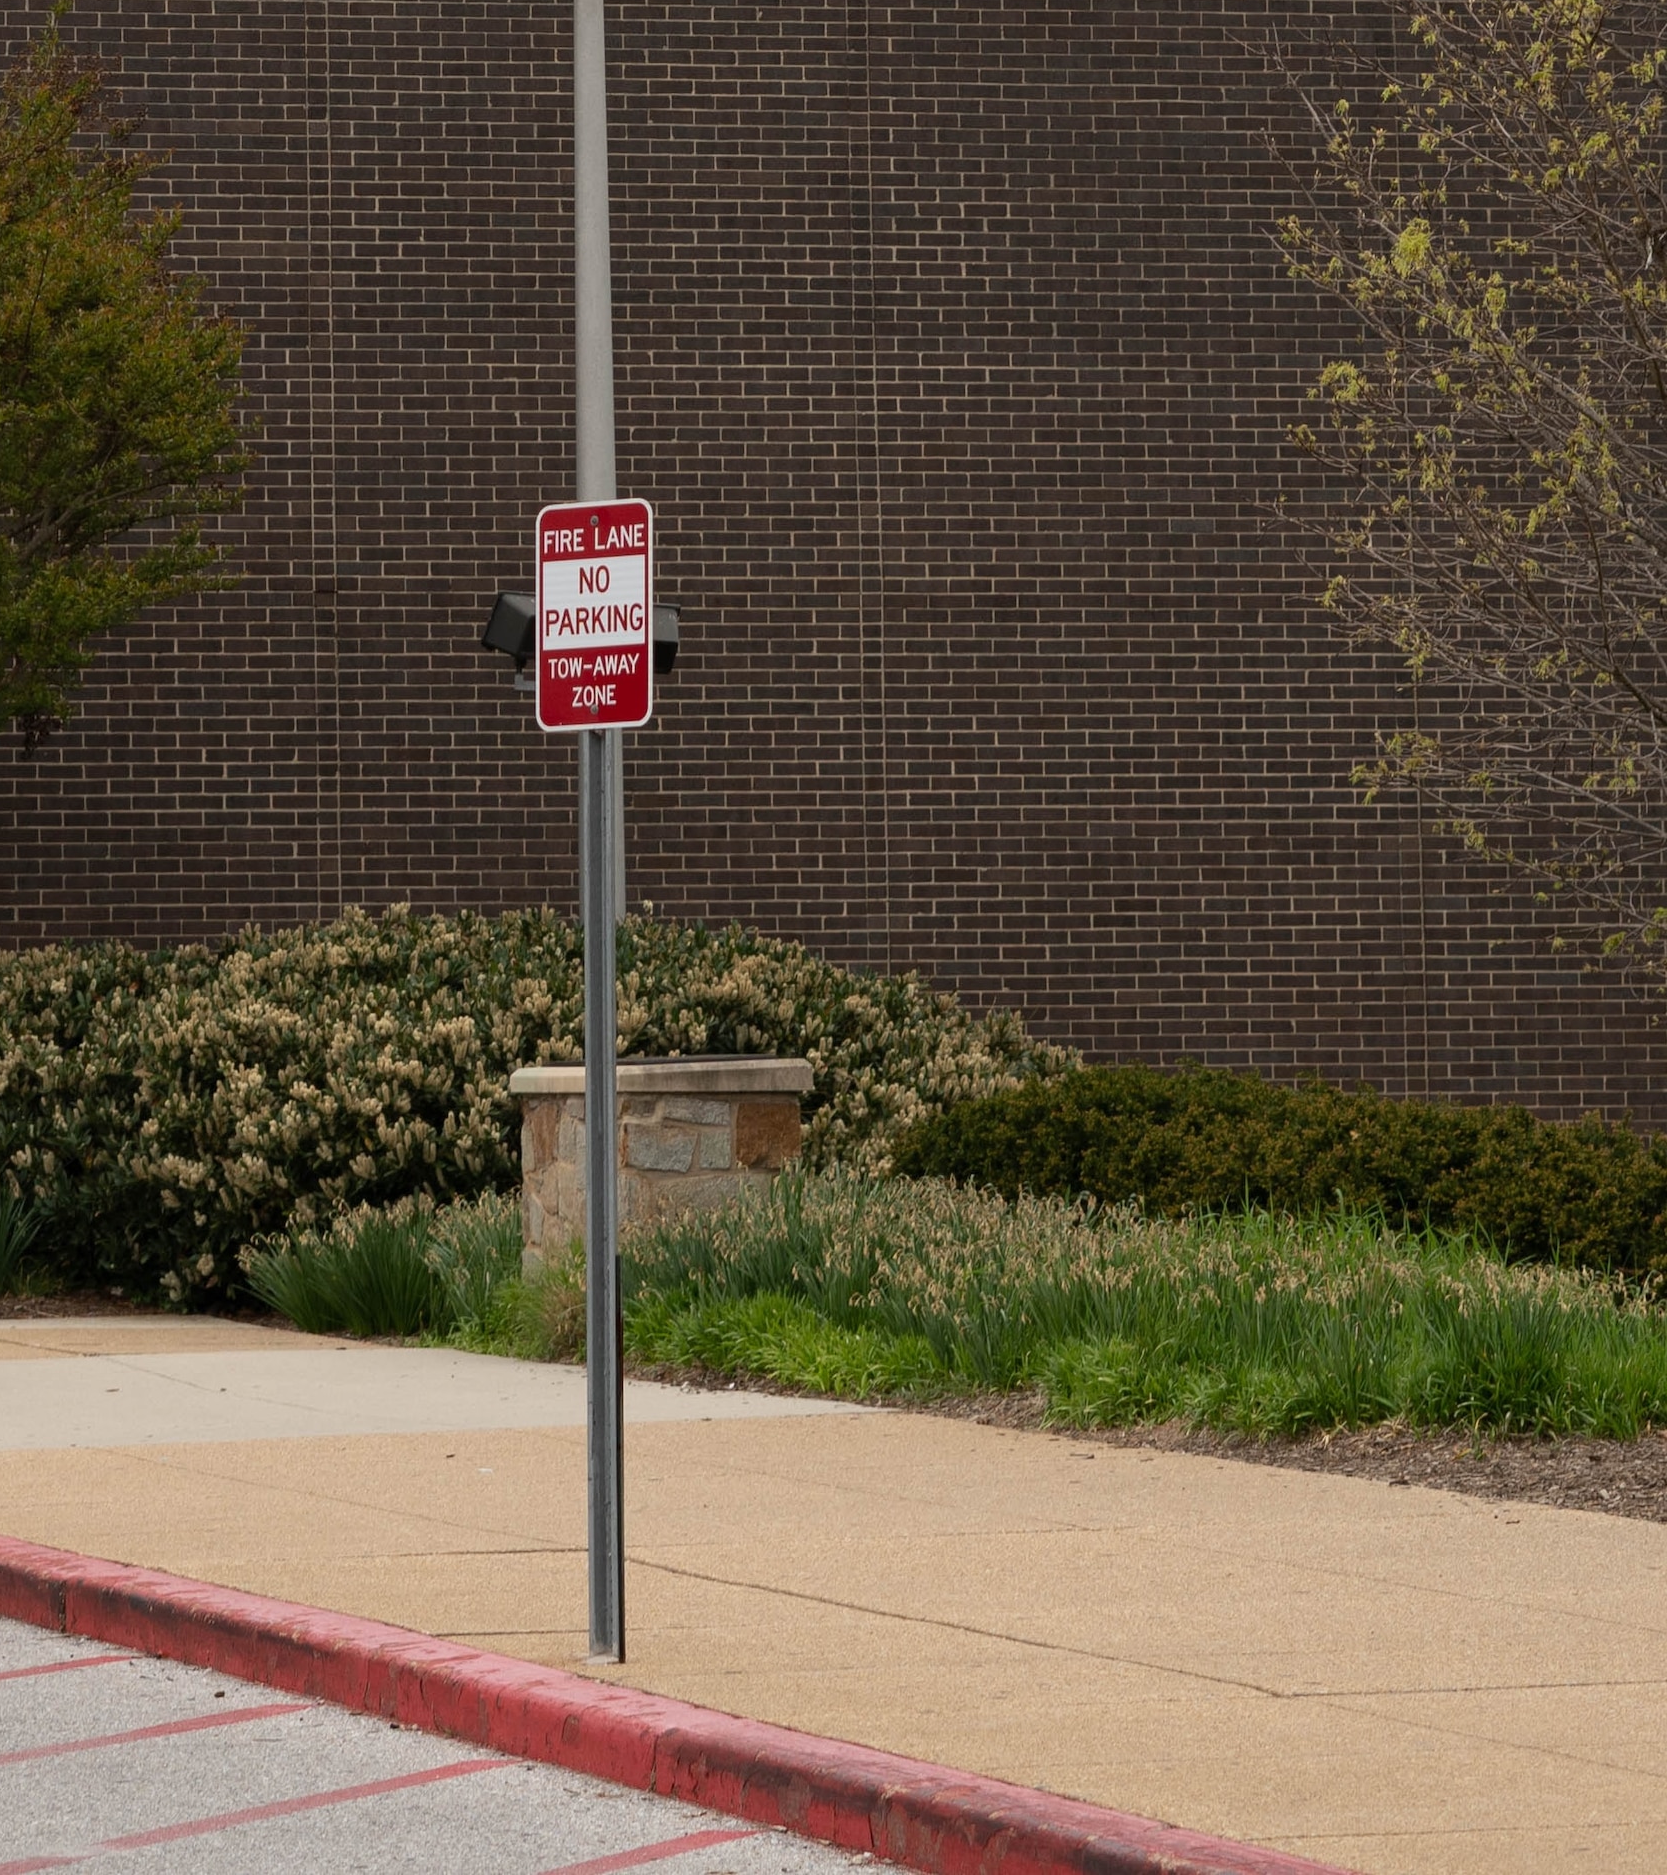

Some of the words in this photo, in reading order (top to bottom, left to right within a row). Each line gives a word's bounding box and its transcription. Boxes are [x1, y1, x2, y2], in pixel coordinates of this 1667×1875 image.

[543, 528, 585, 554] FIRE
[594, 523, 645, 550] LANE
[579, 565, 610, 594] NO
[545, 603, 644, 637] PARKING
[548, 653, 640, 679] TOW-AWAY
[572, 684, 617, 708] ZONE
